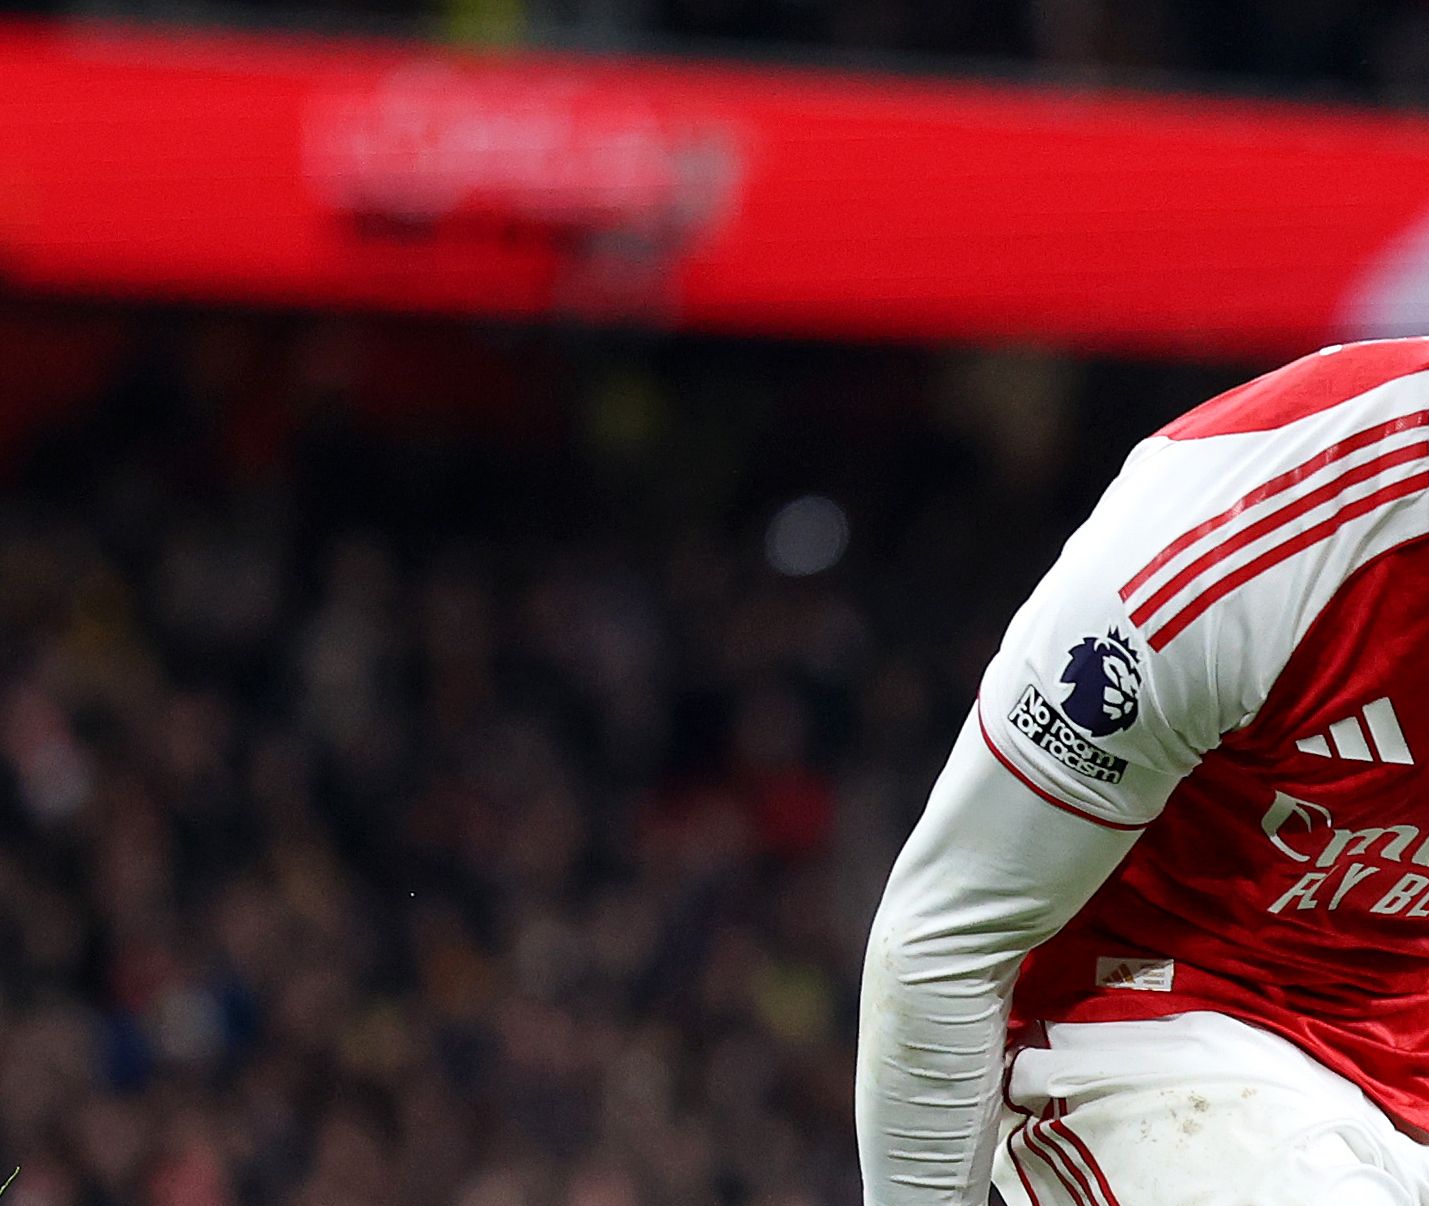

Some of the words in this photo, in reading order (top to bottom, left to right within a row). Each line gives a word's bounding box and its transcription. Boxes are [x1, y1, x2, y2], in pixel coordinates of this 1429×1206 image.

[1008, 703, 1043, 738] for
[1040, 733, 1120, 784] racism
[1019, 686, 1051, 725] No
[1050, 719, 1116, 767] room
